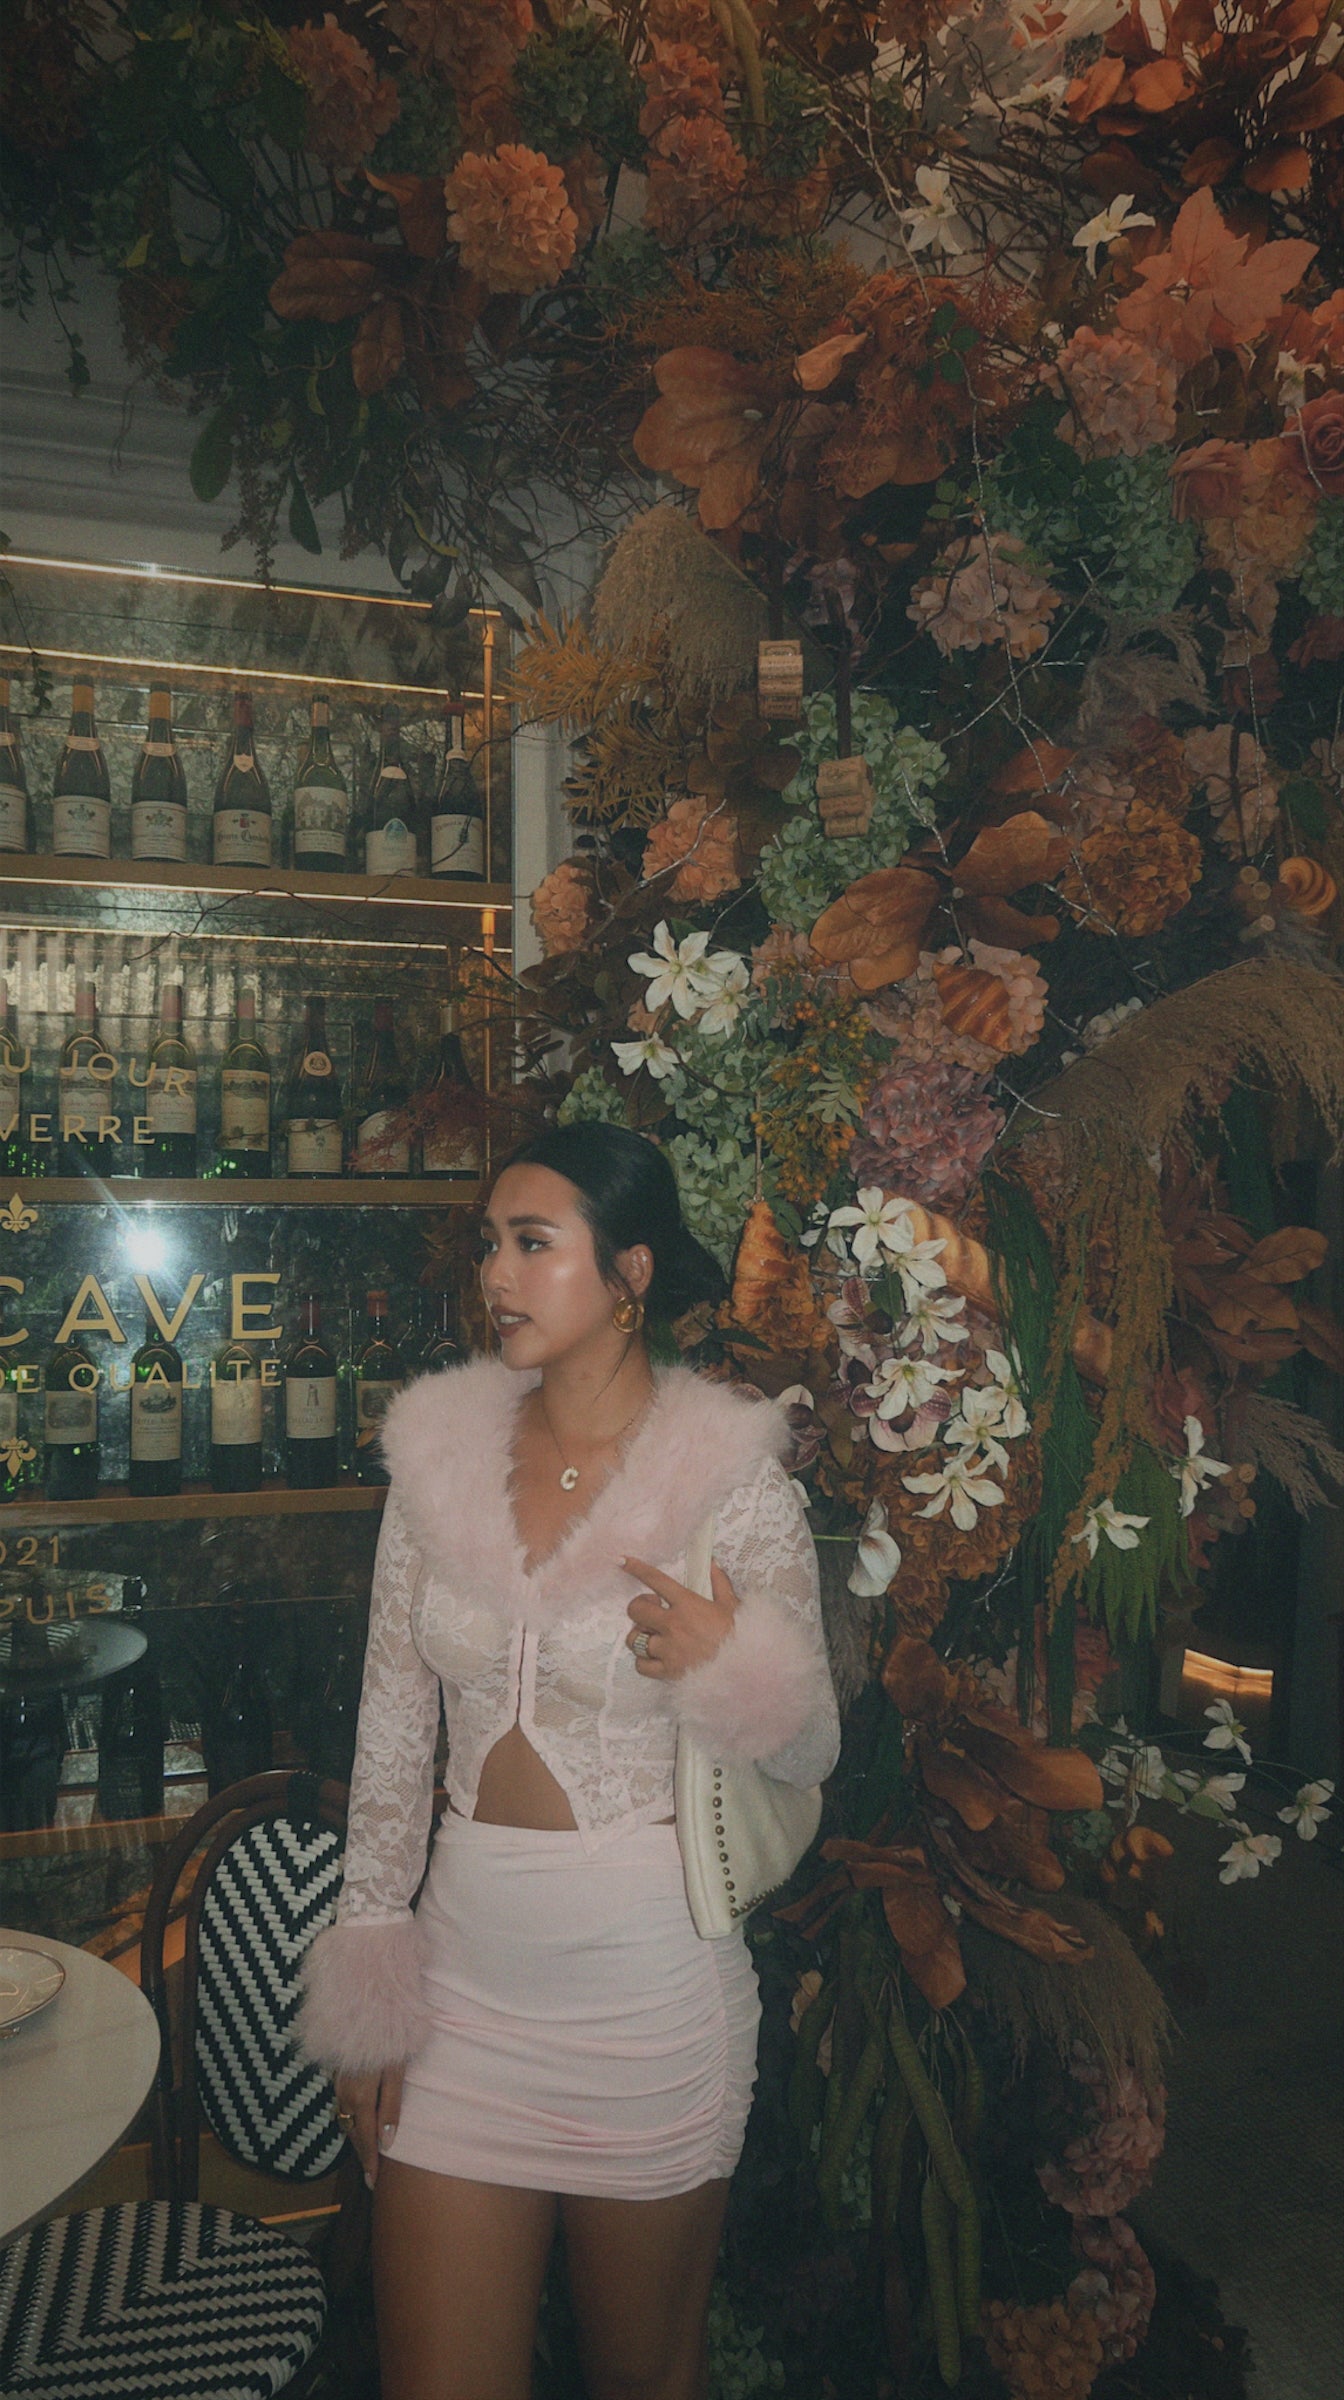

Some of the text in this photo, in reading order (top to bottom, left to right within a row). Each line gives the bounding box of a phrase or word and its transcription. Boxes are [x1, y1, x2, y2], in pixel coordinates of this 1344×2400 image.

[60, 1049, 191, 1097] JOUR
[0, 1113, 156, 1145] VERRE
[0, 1359, 282, 1395] E QUALITE
